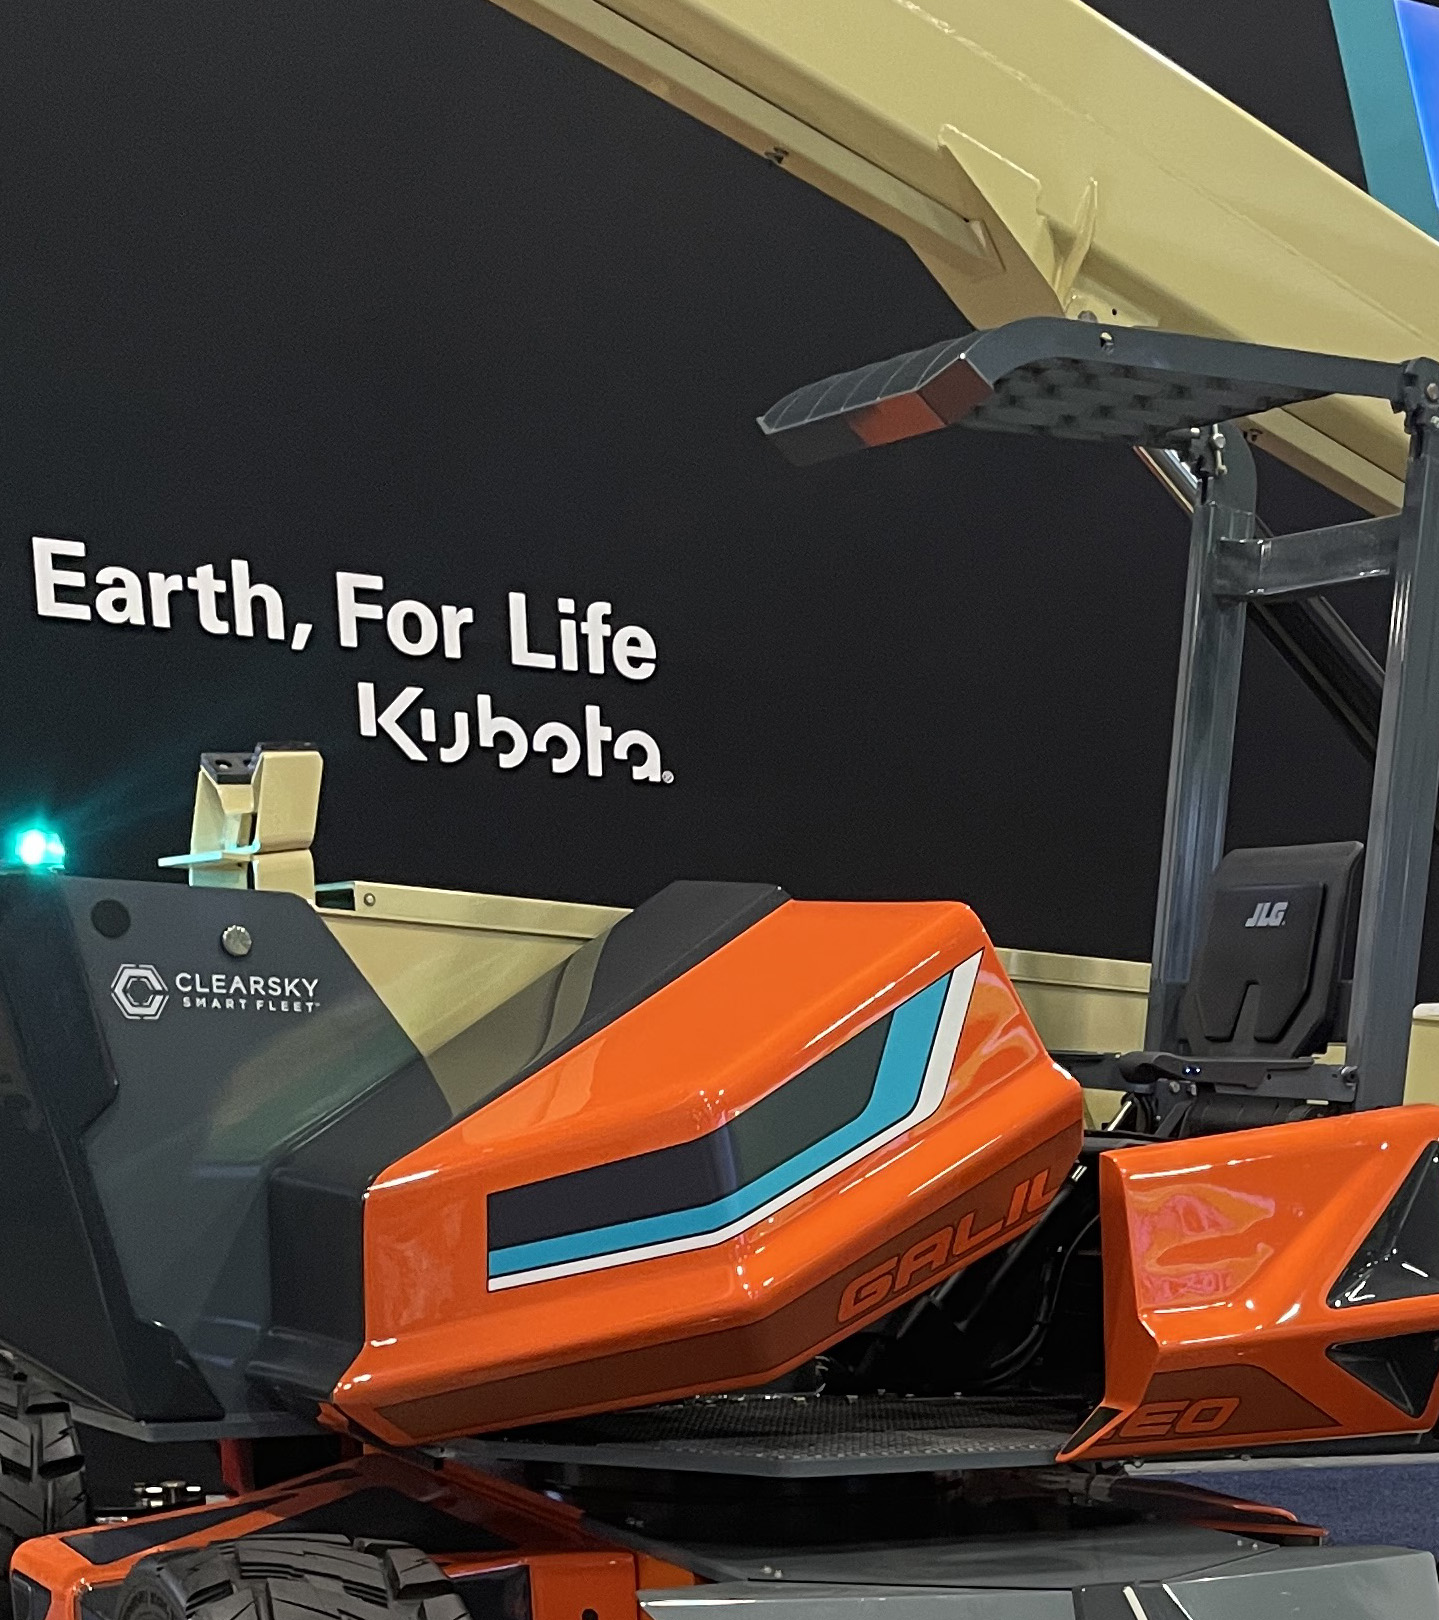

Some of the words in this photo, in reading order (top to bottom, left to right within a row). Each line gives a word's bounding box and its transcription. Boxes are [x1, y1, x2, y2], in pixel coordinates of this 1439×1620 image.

[32, 536, 314, 651] Earth,
[336, 571, 474, 659] For
[508, 591, 657, 680] Life
[358, 681, 663, 783] Kubota
[1245, 901, 1289, 927] JLG
[175, 972, 320, 998] CLEARSKY
[182, 996, 247, 1011] SMART
[256, 1000, 314, 1013] FLEET
[1098, 1396, 1242, 1441] EO
